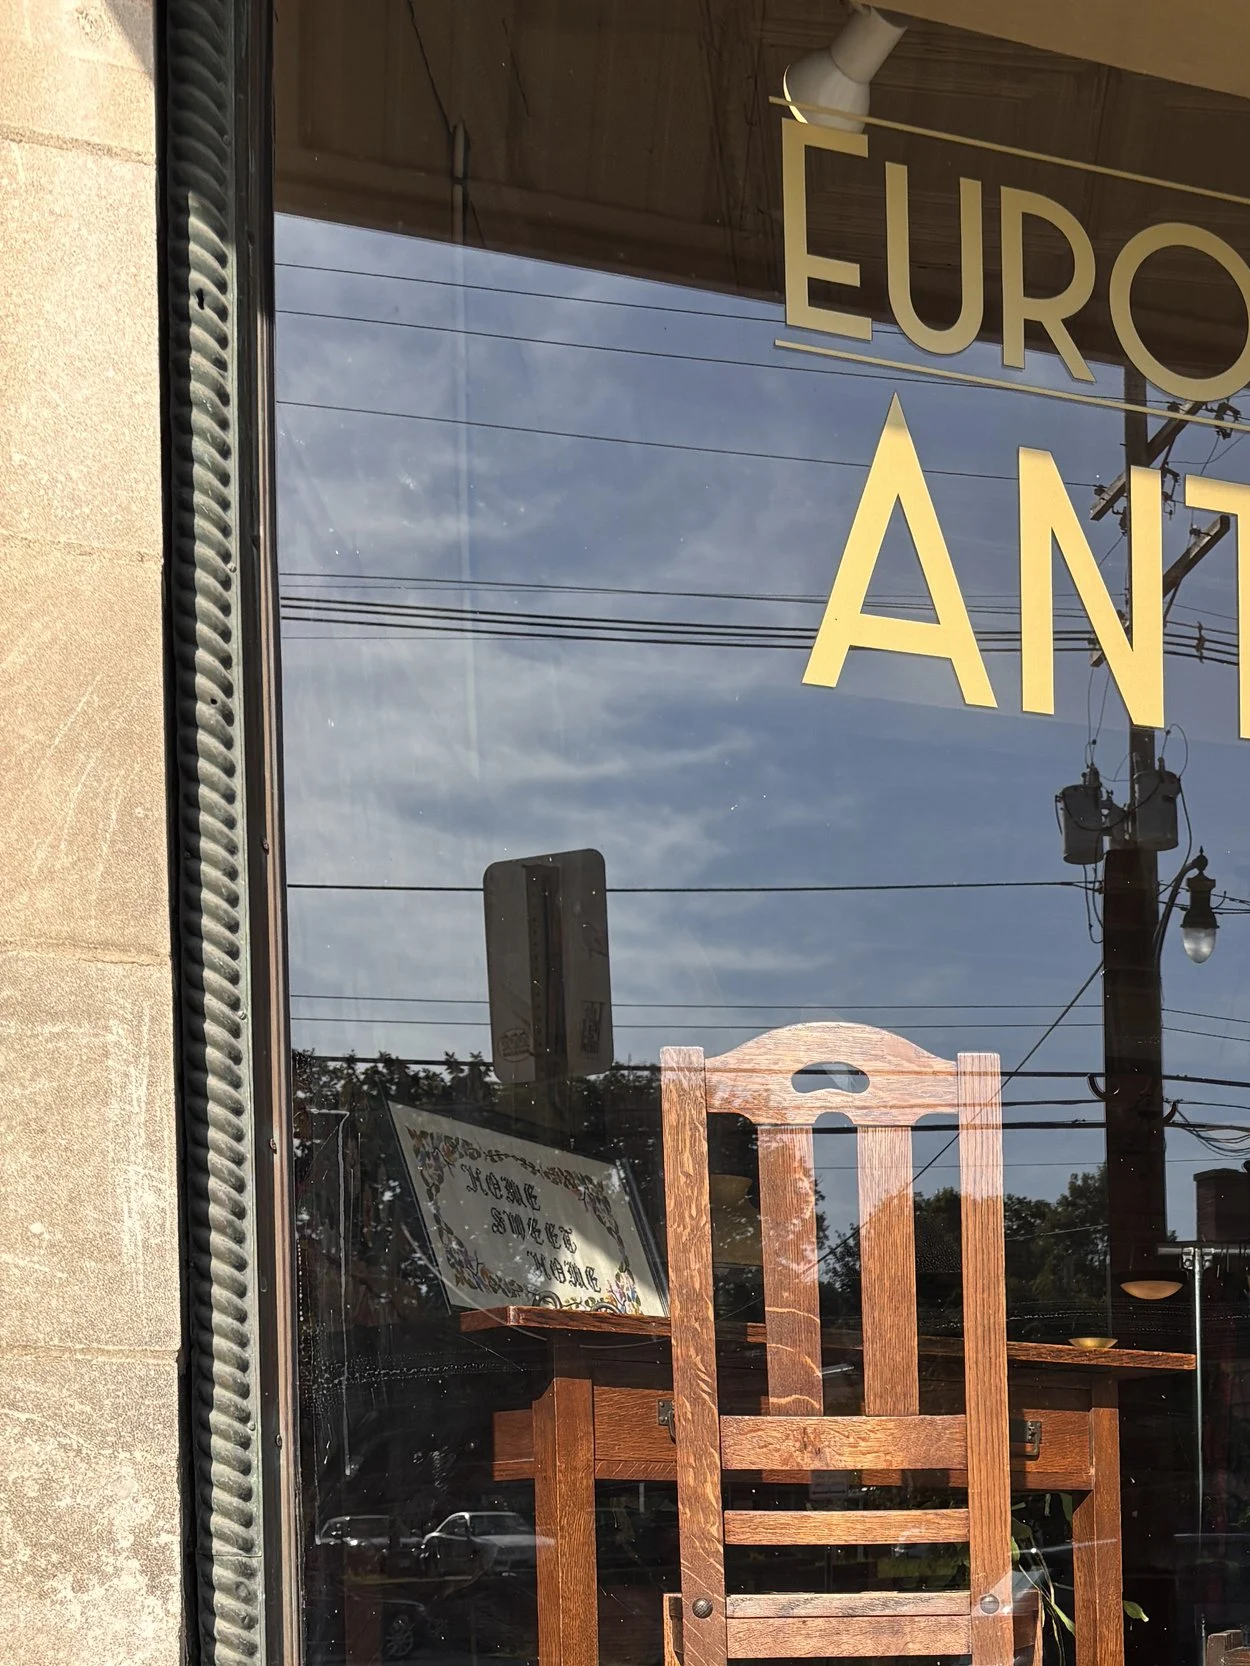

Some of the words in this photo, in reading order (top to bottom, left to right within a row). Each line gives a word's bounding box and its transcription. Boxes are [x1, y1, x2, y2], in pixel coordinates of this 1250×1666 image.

[460, 1163, 541, 1211] HOME
[491, 1207, 577, 1254] SWEET
[527, 1250, 602, 1293] HOME
